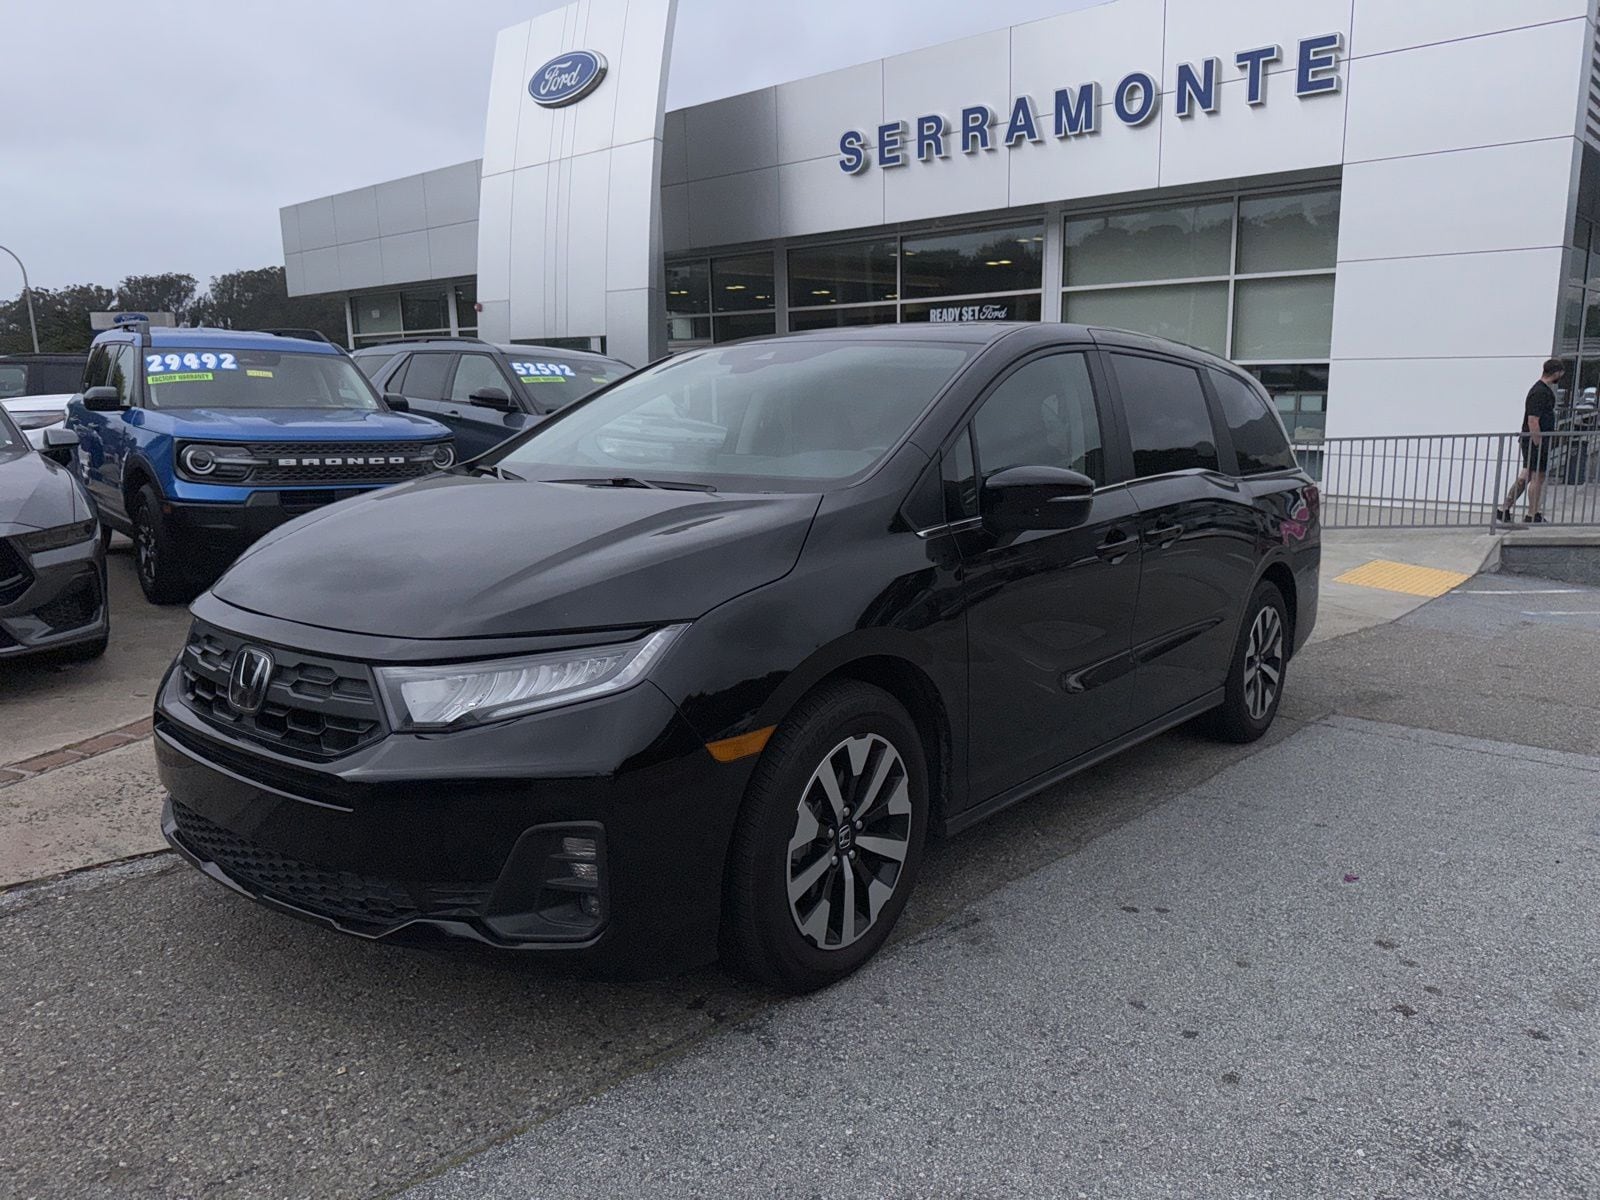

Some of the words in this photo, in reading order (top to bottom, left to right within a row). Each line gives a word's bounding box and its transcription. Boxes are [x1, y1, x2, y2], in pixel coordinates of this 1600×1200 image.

[540, 60, 582, 95] Ford
[839, 32, 1342, 175] SERRAMONTE
[929, 307, 960, 322] READY
[961, 306, 980, 321] SET
[980, 304, 1008, 319] Ford
[146, 352, 238, 372] 29492
[510, 362, 577, 377] 52592
[278, 456, 405, 466] BRONCO
